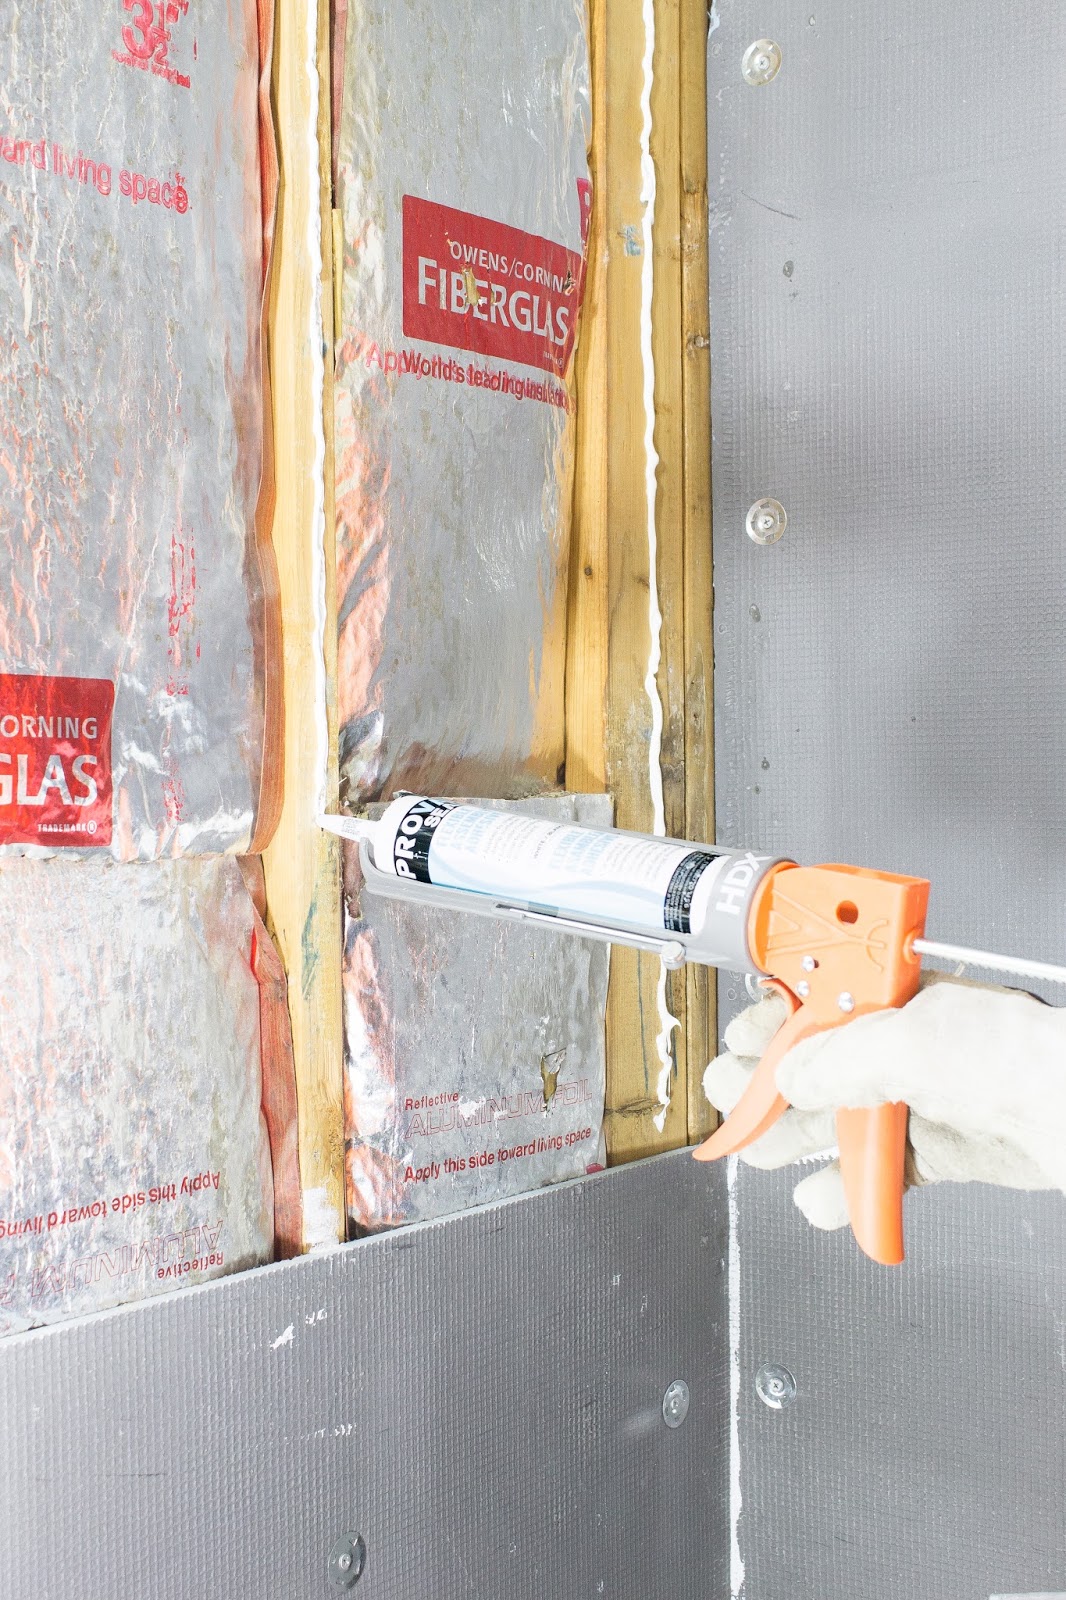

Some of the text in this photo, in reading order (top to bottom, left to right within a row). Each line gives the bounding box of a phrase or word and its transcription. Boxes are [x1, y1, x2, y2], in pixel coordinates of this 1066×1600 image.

[52, 142, 112, 195] living
[118, 169, 189, 214] space
[417, 255, 570, 347] FIBERGLAS
[394, 799, 446, 880] PROV
[715, 851, 772, 916] HDX
[405, 1092, 459, 1111] Reflective
[404, 1127, 592, 1183] Apply this side toward living space
[0, 1171, 220, 1240] Apply this side toward living
[157, 1251, 224, 1279] Reflective
